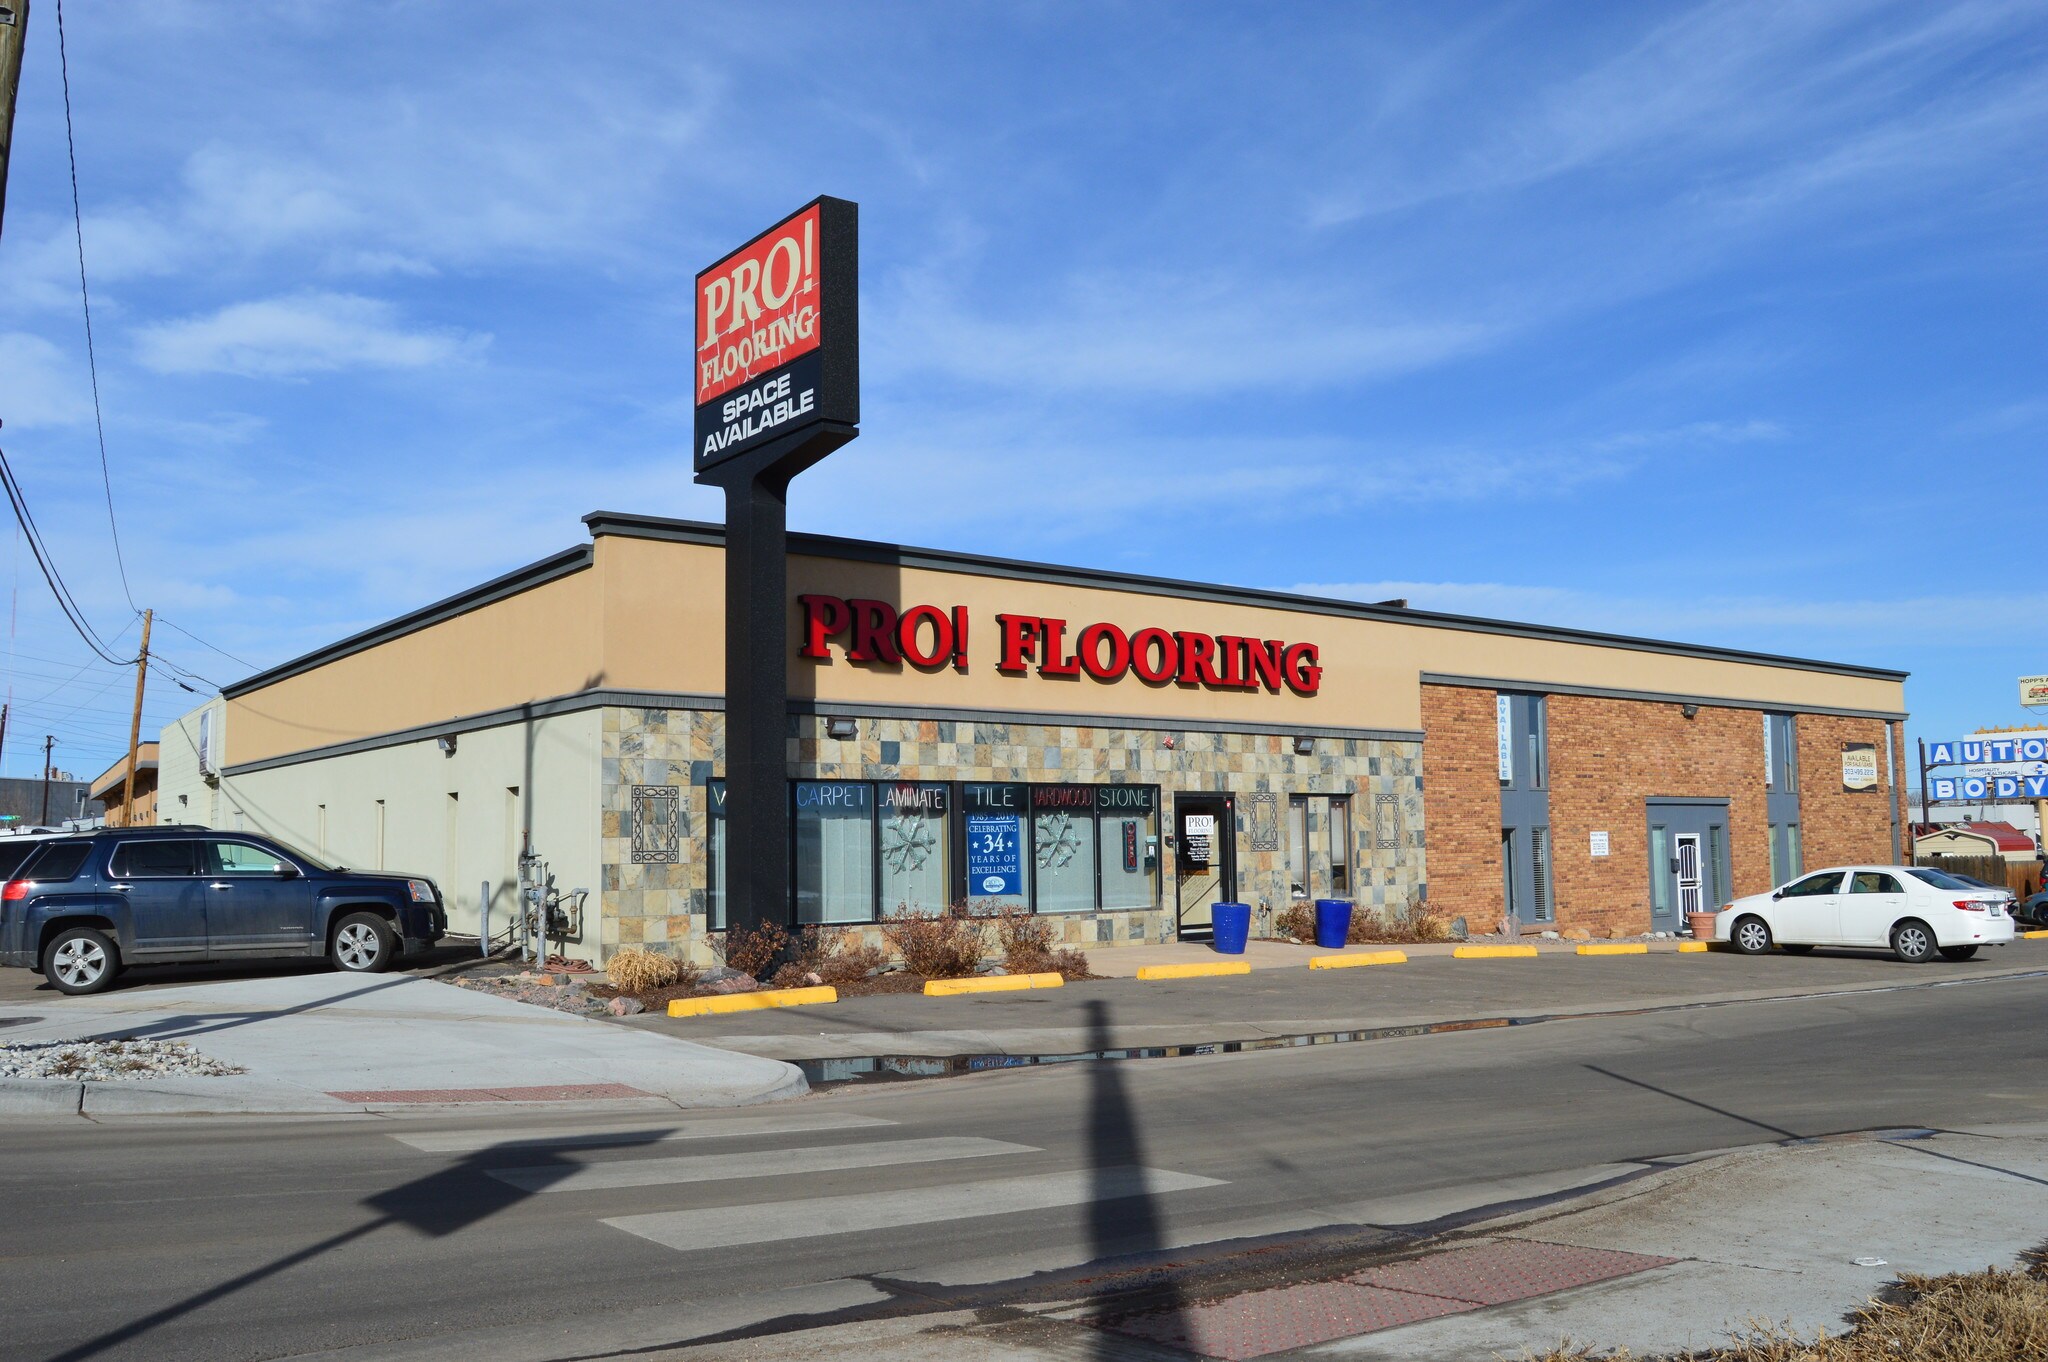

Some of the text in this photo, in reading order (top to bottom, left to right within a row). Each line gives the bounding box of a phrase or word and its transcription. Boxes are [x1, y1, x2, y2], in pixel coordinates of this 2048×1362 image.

[704, 218, 813, 350] PRO!
[702, 305, 814, 389] FLOORING
[722, 373, 790, 423] SPACE
[703, 389, 814, 457] AVAILABLE
[797, 594, 1323, 693] PRO! FLOORING
[1499, 698, 1508, 778] AVAILABLE
[1933, 740, 2044, 763] AUTO
[797, 785, 866, 807] CARPET
[879, 787, 943, 809] AMINATE
[973, 786, 1015, 808] TILE
[1099, 788, 1151, 808] STONE
[1935, 777, 2046, 798] BODY
[969, 825, 1017, 833] CELEBRATING
[1188, 816, 1212, 828] PRO!
[983, 833, 1005, 854] 34
[1126, 821, 1137, 867] OPEN
[971, 854, 1017, 863] YEARS OF
[971, 865, 1017, 875] EXCELLENCE
